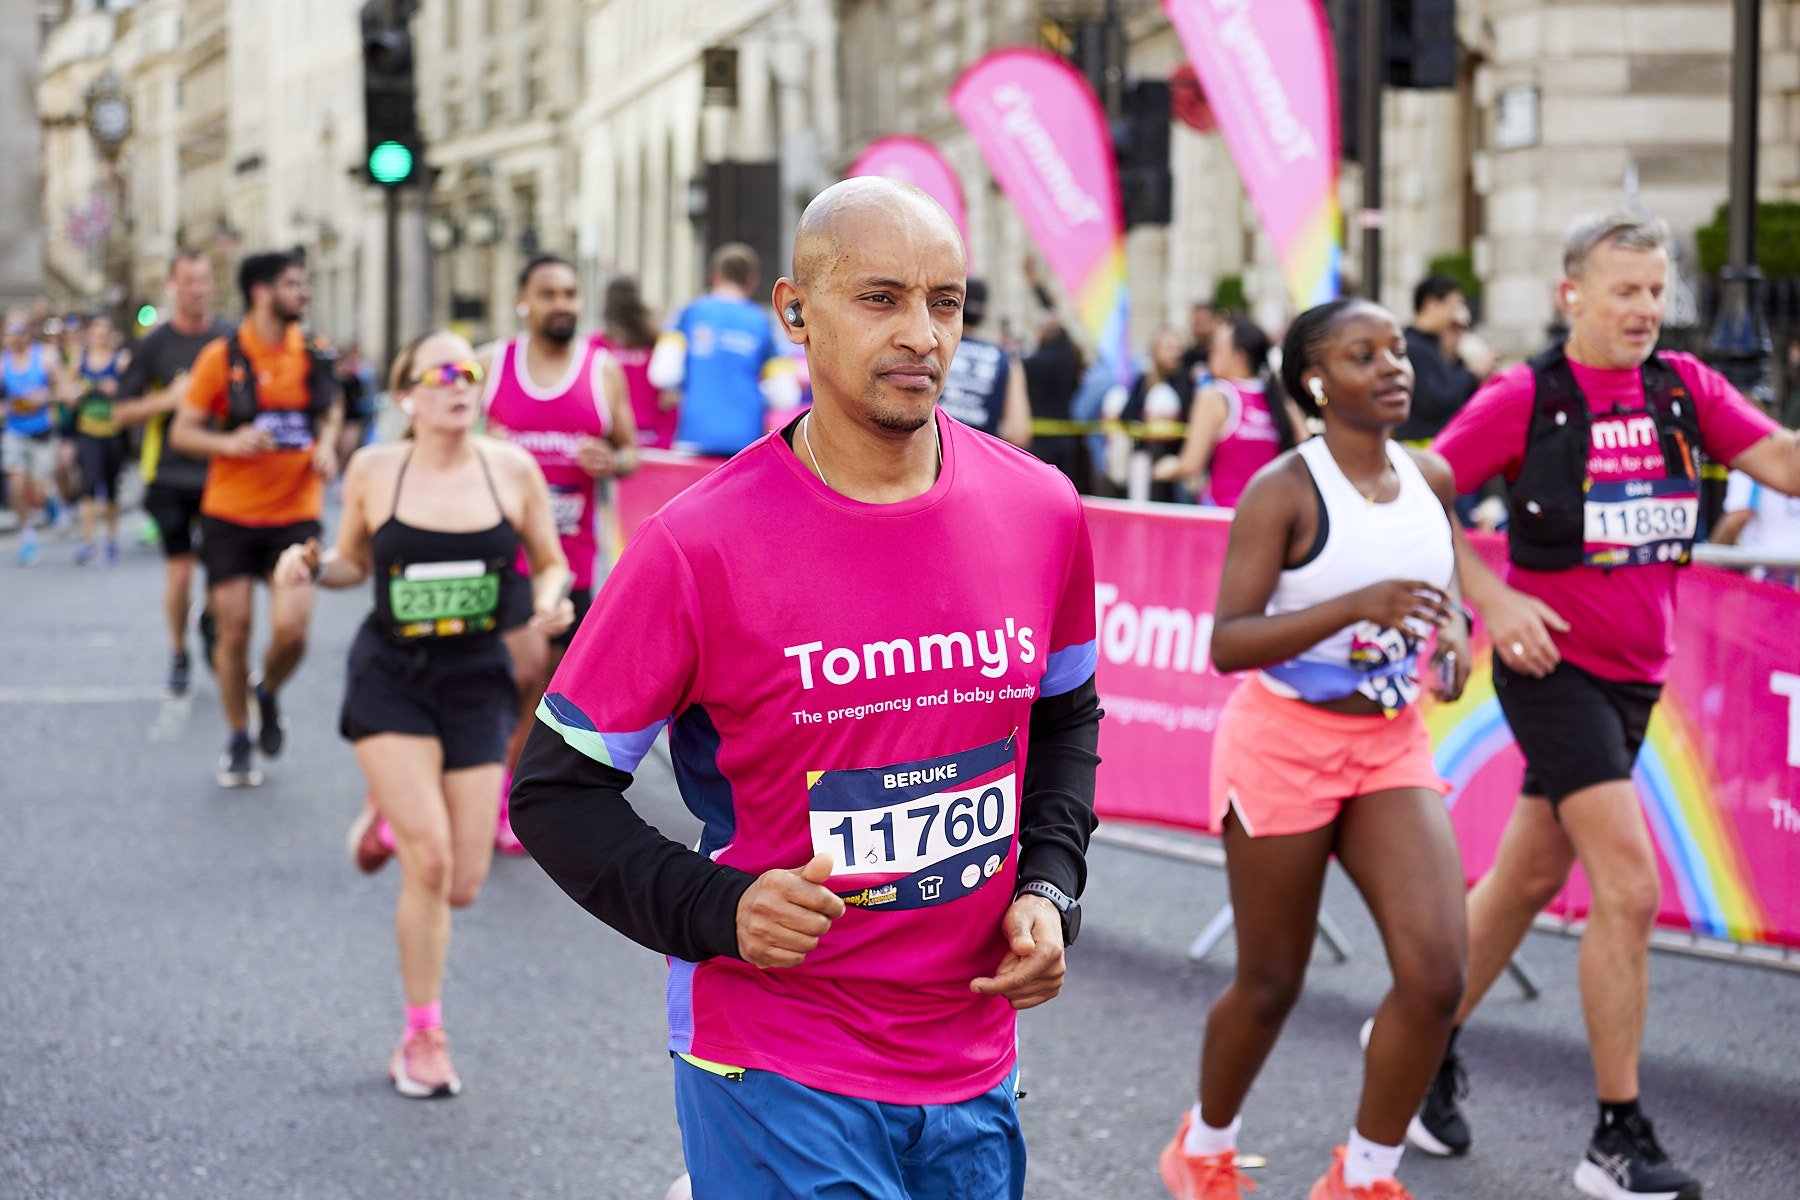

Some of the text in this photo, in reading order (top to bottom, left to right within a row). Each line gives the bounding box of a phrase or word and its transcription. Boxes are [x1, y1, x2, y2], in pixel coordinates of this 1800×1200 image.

[1598, 505, 1687, 537] 11839
[784, 617, 1036, 690] Tommy's
[792, 684, 1036, 725] The pregnancy and baby charity
[883, 763, 958, 789] BERUKE
[829, 786, 1005, 867] 11760
